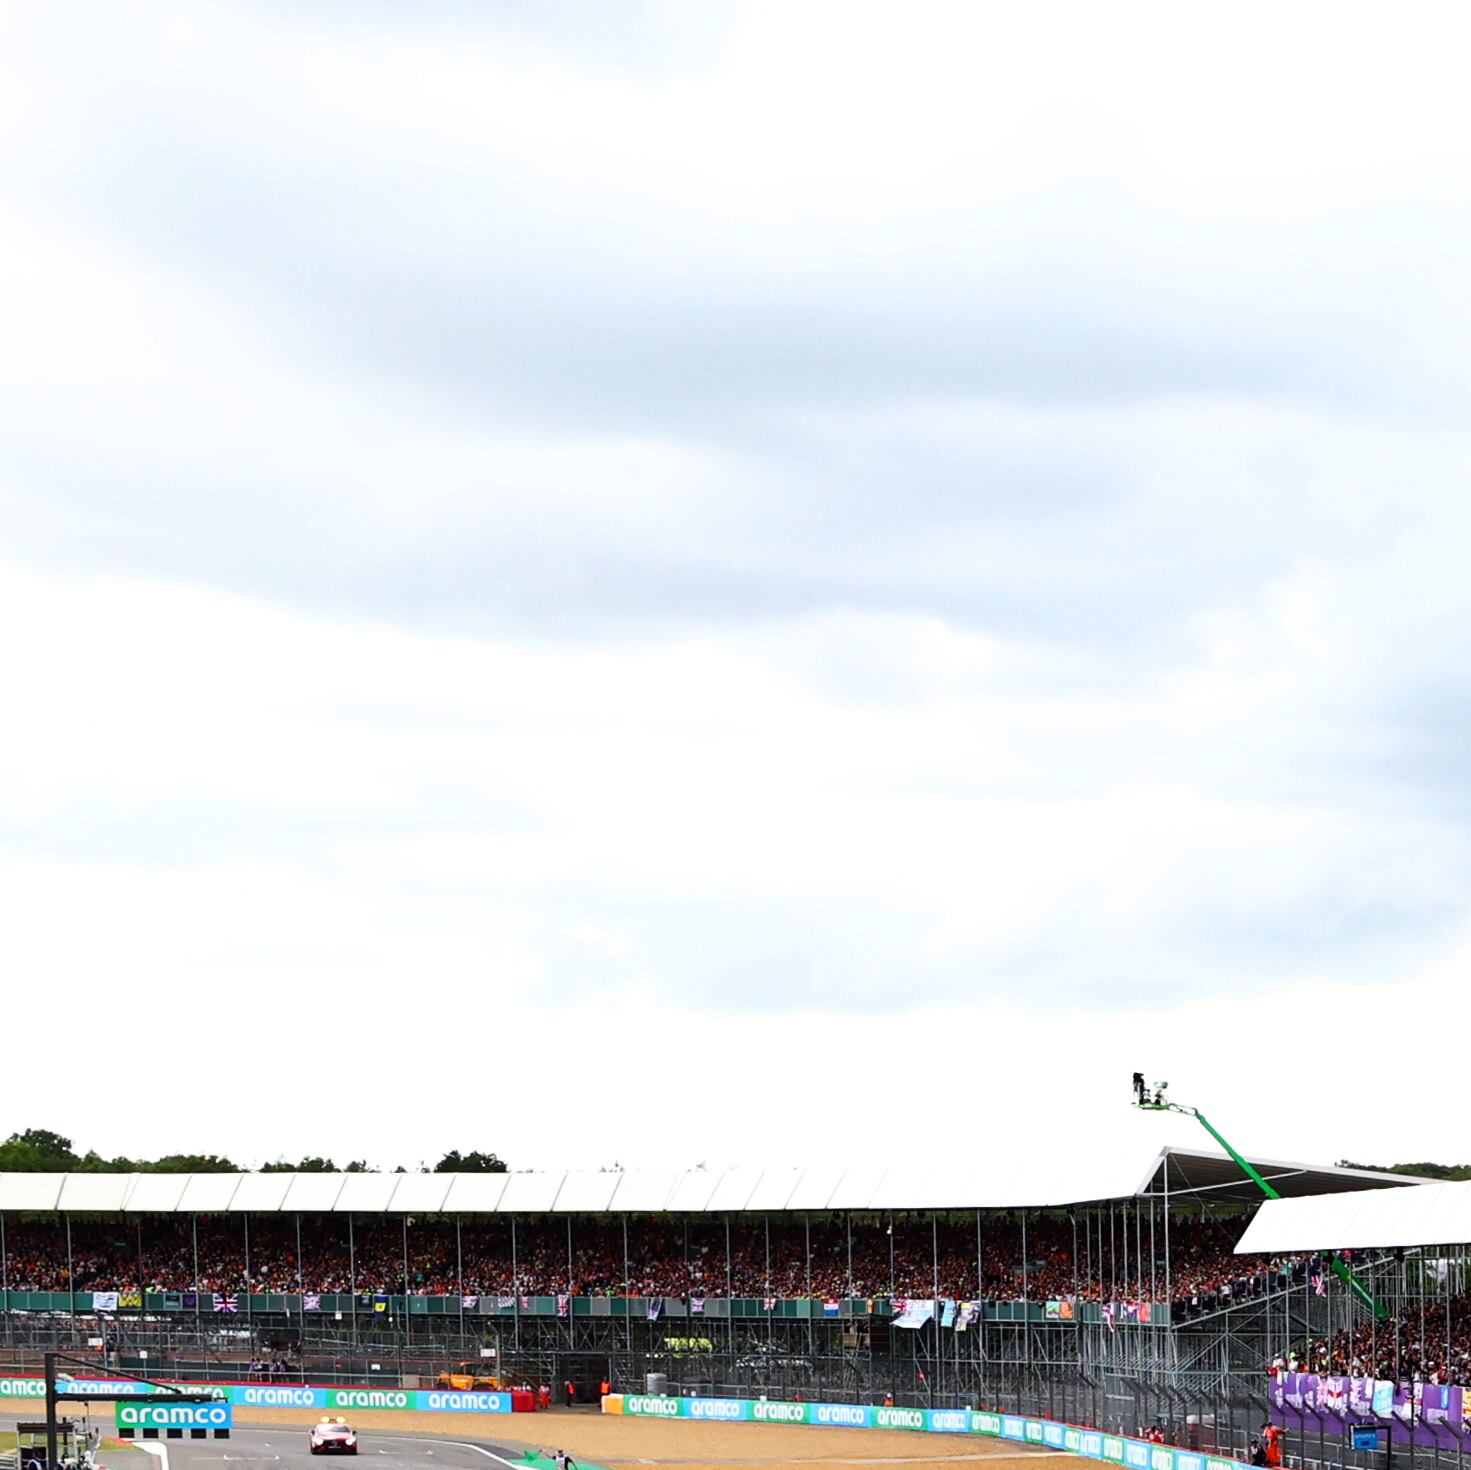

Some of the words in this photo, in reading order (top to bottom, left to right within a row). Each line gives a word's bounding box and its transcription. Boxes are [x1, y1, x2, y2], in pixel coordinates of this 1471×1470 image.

[245, 1388, 314, 1405] aramco
[336, 1391, 407, 1407] aramco
[428, 1393, 500, 1409] aramco
[629, 1396, 677, 1415] aramco
[121, 1407, 226, 1424] aramco
[692, 1400, 740, 1419] aramco
[754, 1401, 803, 1420] aramco
[818, 1405, 864, 1424] aramco
[878, 1406, 922, 1427] aramco
